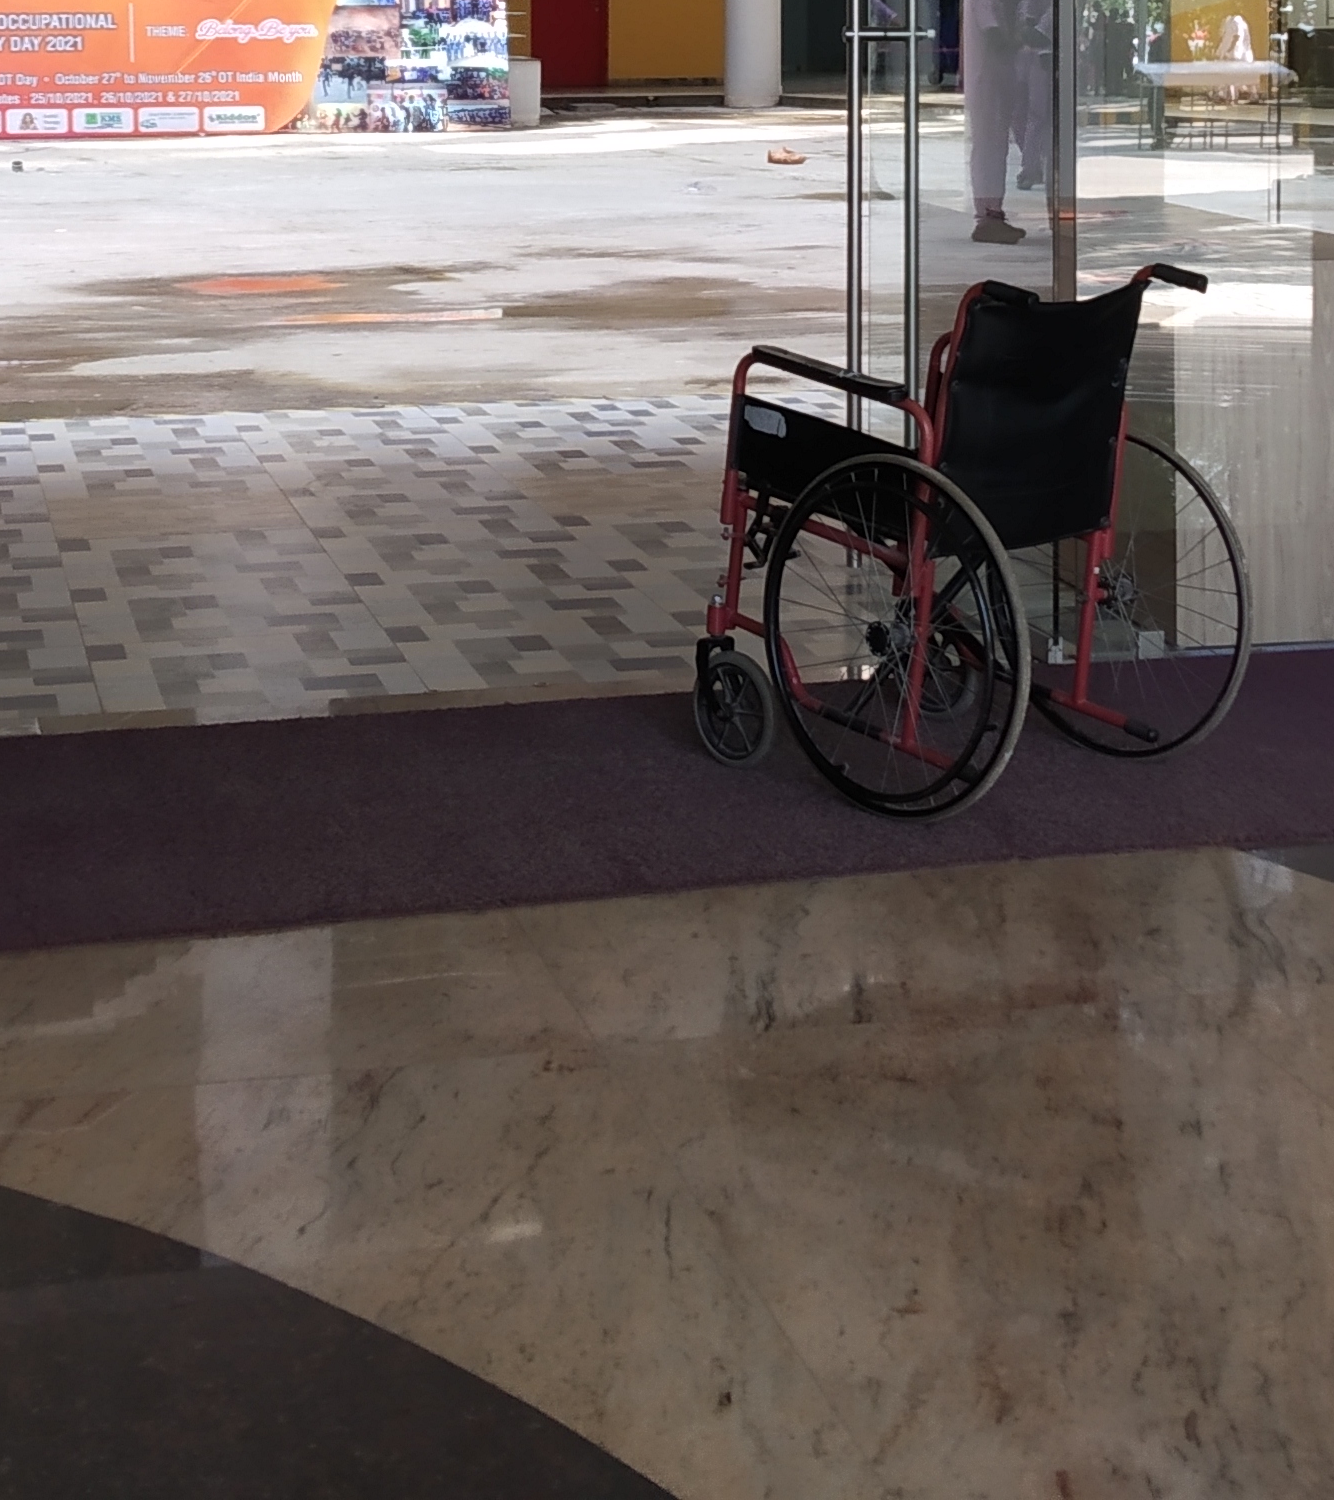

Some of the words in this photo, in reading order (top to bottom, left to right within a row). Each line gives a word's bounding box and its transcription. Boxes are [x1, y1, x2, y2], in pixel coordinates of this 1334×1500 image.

[10, 36, 43, 51] DAY
[46, 36, 83, 51] 2021
[16, 74, 38, 88] Day
[267, 71, 303, 83] Month
